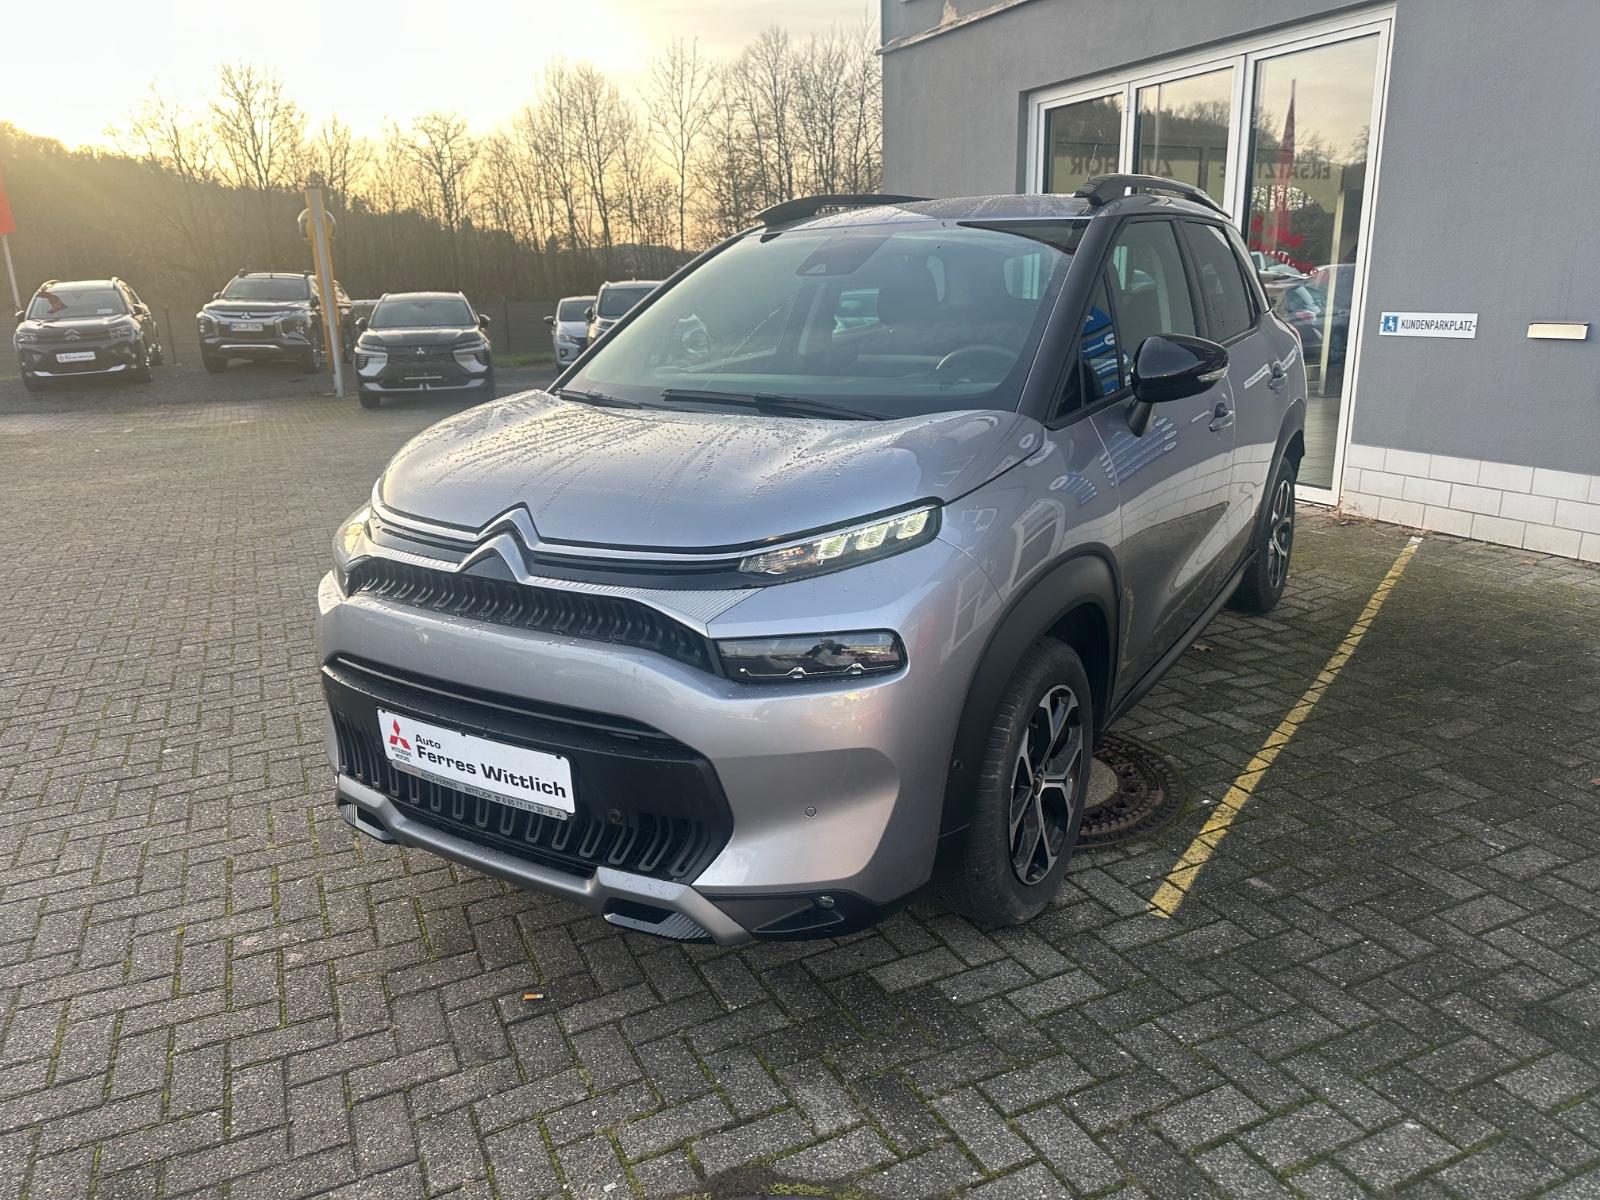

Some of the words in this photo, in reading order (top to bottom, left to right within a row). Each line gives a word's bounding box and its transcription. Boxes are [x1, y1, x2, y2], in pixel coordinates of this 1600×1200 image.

[1401, 319, 1473, 331] KUNDENPARKPLATZ
[416, 734, 441, 749] Auto
[417, 745, 476, 775] Ferres
[481, 763, 567, 798] Wittlich
[464, 787, 491, 799] WITTLICH
